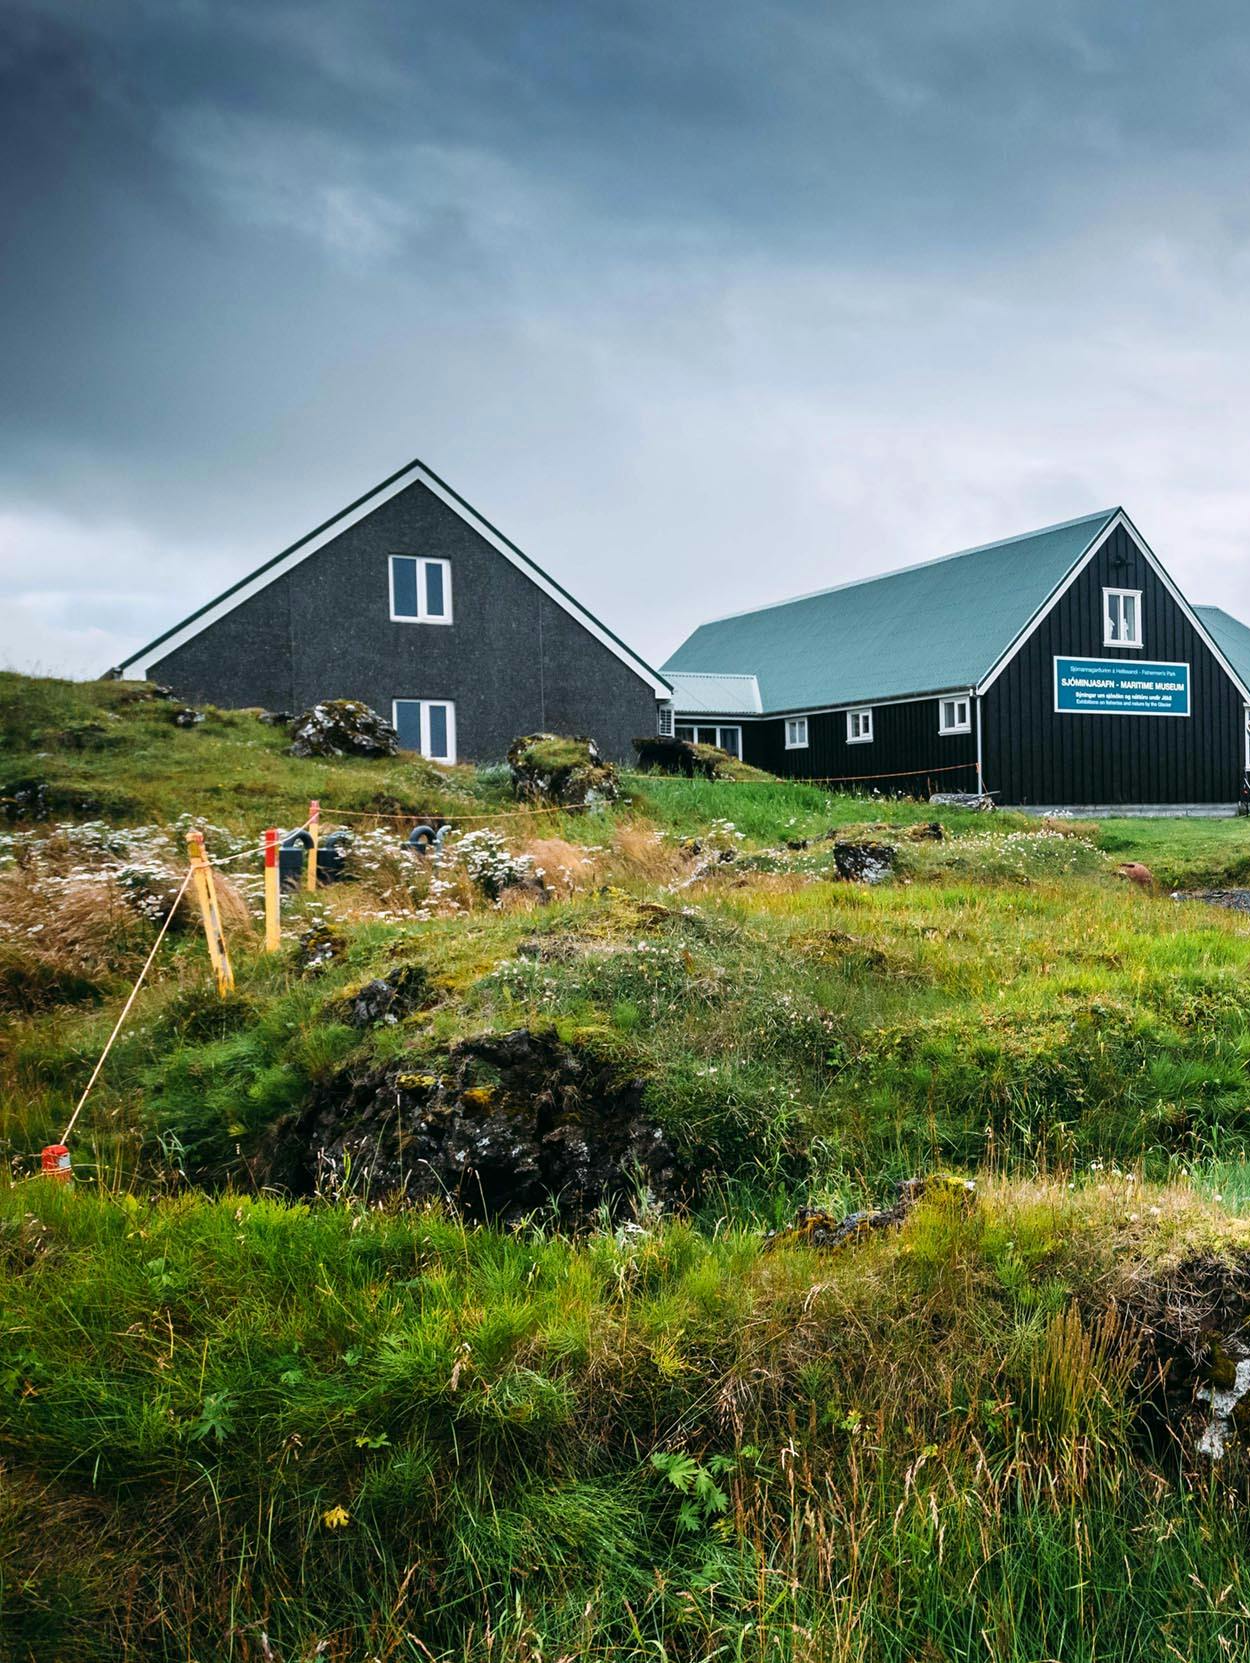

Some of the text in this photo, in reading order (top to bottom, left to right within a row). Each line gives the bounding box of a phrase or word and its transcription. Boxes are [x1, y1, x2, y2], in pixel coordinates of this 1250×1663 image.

[1061, 676, 1115, 688] SJÓMINJASAFN
[1120, 681, 1153, 690] MARITIME
[1155, 682, 1184, 691] MUSEUM
